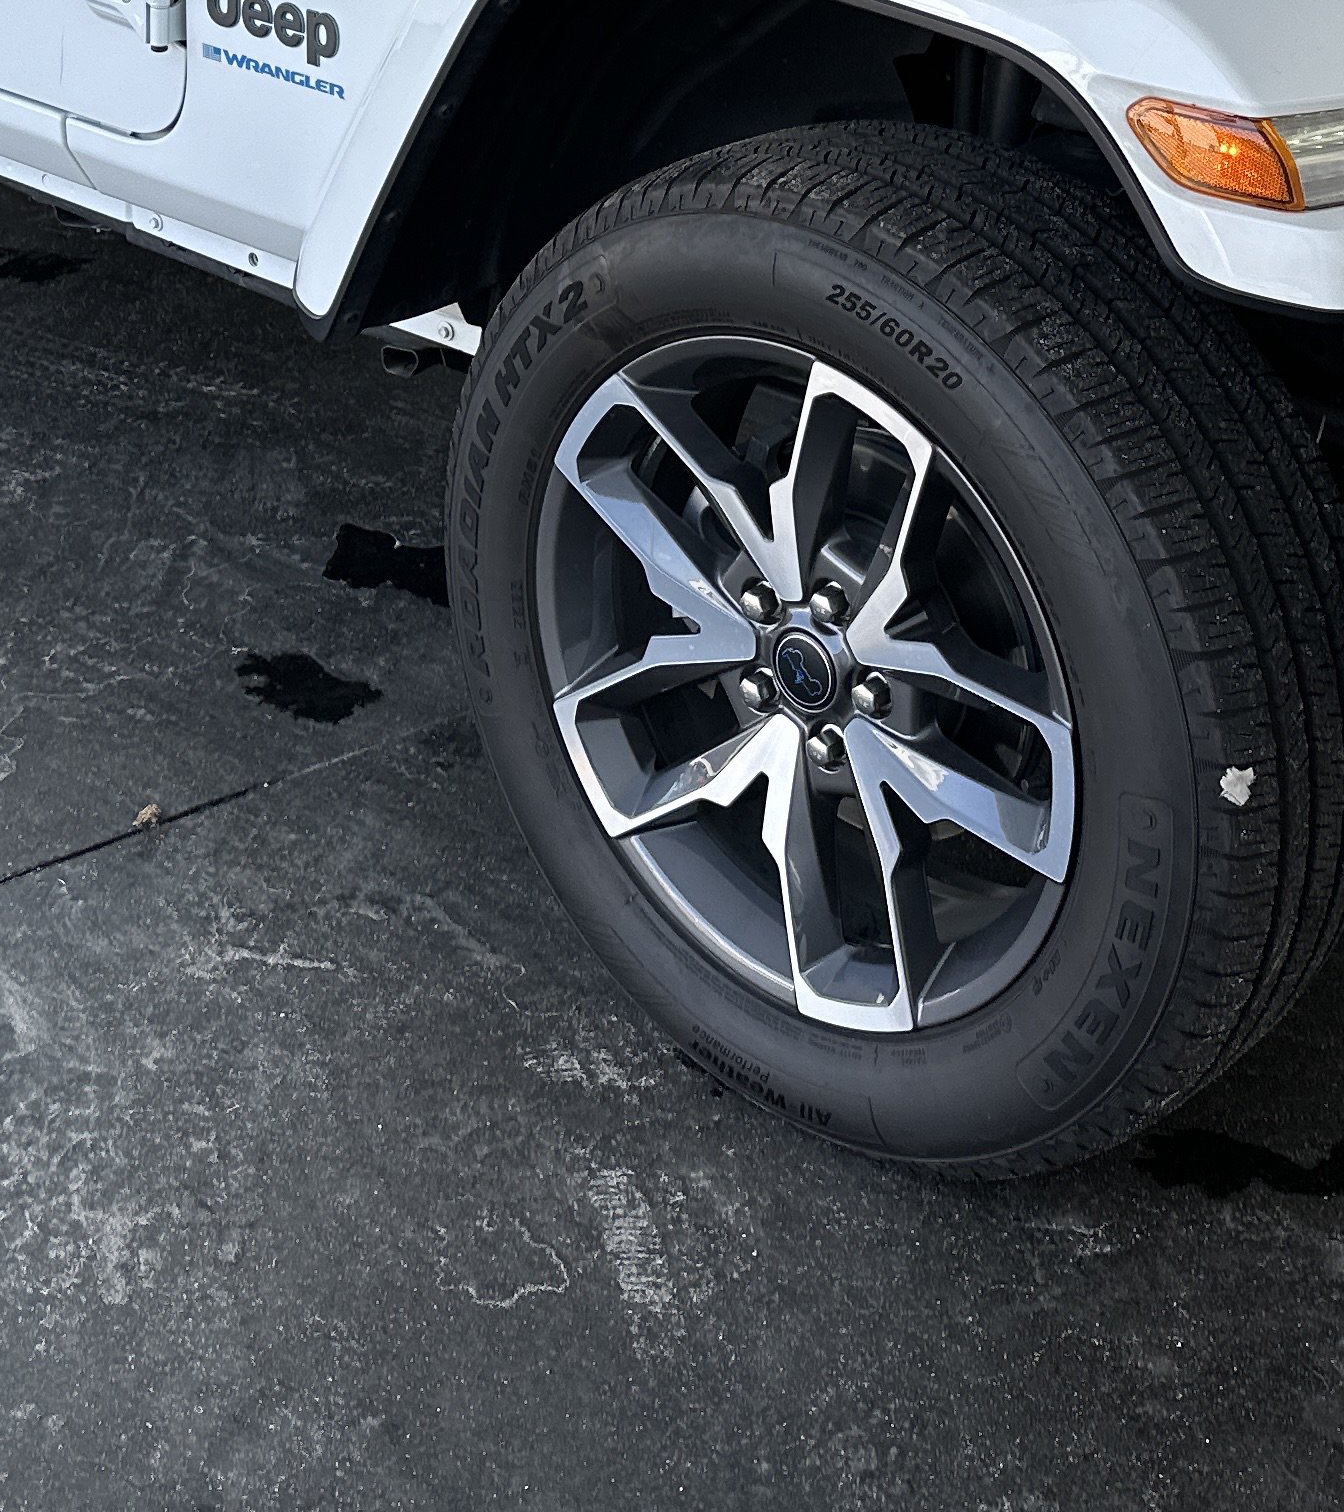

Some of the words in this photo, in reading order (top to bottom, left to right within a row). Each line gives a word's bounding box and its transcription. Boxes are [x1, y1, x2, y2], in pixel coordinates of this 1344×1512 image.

[222, 49, 346, 100] WRANGLER
[825, 284, 963, 390] 255/60R20
[458, 397, 501, 678] ROADIAN
[1043, 838, 1161, 1083] NEXEN
[692, 1024, 771, 1083] Performance
